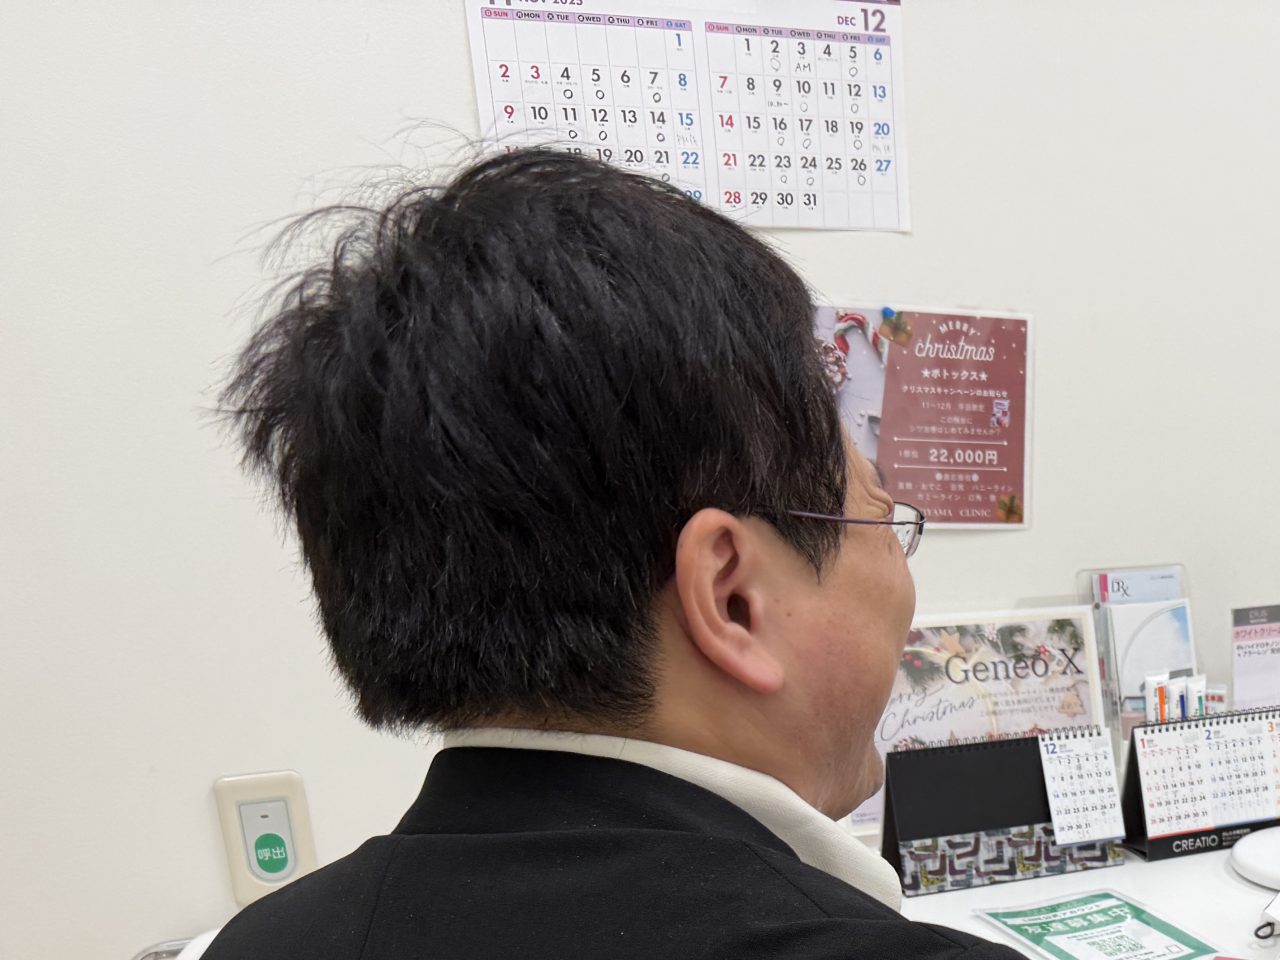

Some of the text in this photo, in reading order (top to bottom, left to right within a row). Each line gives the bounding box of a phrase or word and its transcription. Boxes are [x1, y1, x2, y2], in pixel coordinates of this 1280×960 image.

[837, 9, 886, 33] DEC 12
[676, 33, 682, 47] 1
[744, 39, 882, 61] 1 2 3 4 5 6
[499, 64, 687, 87] 2 3 4 5 6 7 8
[719, 76, 886, 99] 7 8 9 10 11 12 13
[504, 105, 694, 126] 9 10 11 12 13 14 15
[719, 115, 890, 135] 14 15 16 17 18 19 20
[597, 149, 612, 162] 19
[625, 150, 643, 163] 20
[655, 151, 669, 164] 21
[682, 152, 699, 165] 22
[723, 153, 891, 172] 21 22 23 24 25 26 27
[724, 192, 817, 207] 28 29 30 31
[938, 320, 975, 336] MERRY
[915, 335, 995, 361] christmas
[929, 449, 998, 465] 22,000円
[960, 509, 991, 517] CLINIC
[945, 648, 1084, 684] Geneo X
[880, 696, 975, 742] Christmas
[1267, 721, 1275, 733] 3
[1205, 730, 1212, 740] 2
[1044, 743, 1057, 755] 12
[1173, 835, 1219, 852] CREATIO
[257, 846, 286, 860] 呼出
